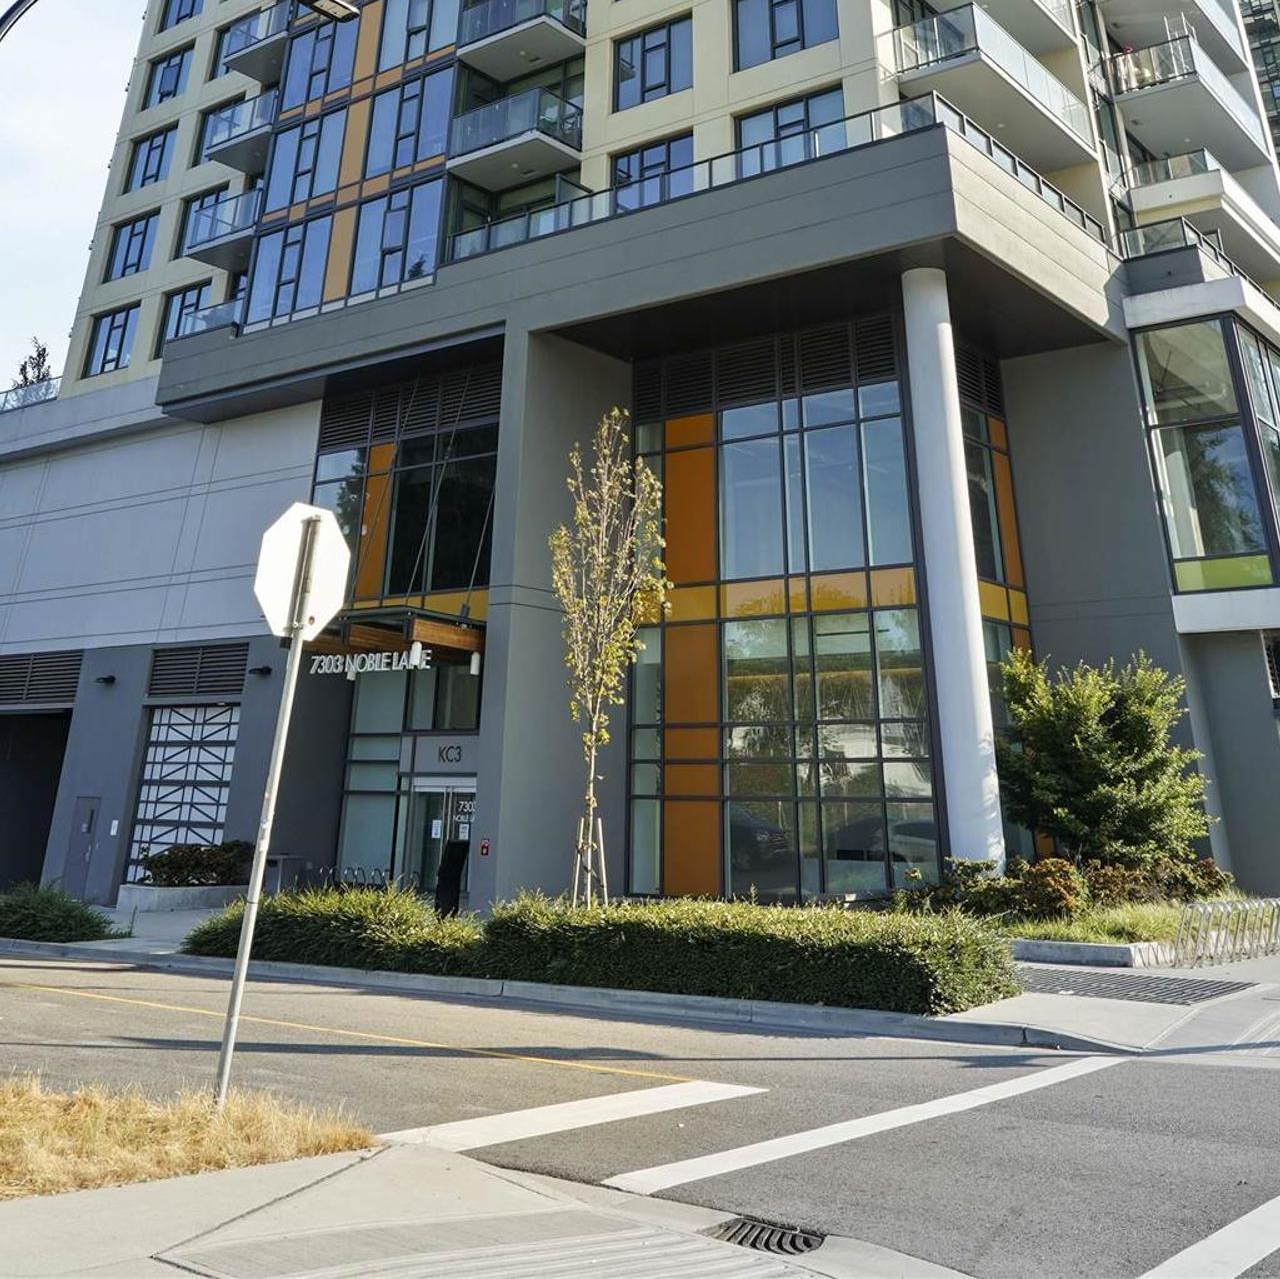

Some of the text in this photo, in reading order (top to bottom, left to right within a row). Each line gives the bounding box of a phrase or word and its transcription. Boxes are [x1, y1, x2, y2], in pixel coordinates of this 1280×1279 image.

[310, 654, 344, 674] 7303
[345, 652, 391, 672] NOBLE
[438, 745, 462, 763] KC3
[459, 800, 477, 814] 730
